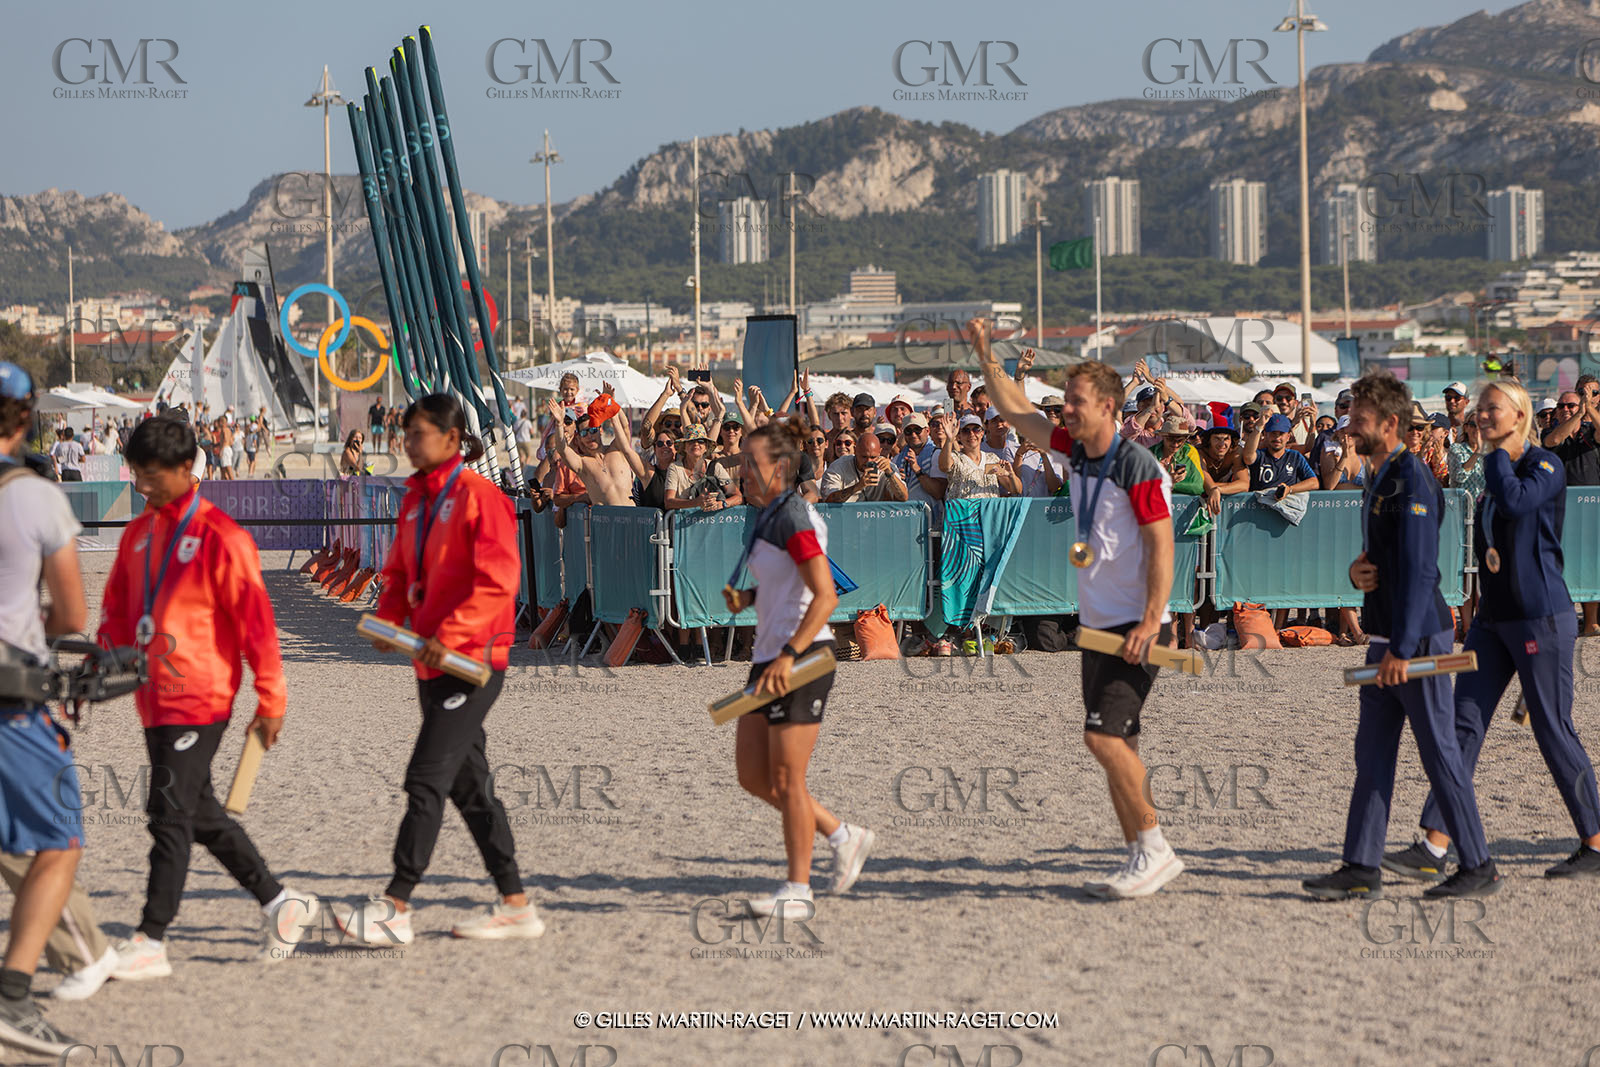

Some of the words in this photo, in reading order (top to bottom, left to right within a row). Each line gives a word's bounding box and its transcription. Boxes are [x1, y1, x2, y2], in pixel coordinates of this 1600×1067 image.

[1259, 466, 1274, 484] 10
[226, 495, 291, 516] PARIS
[1228, 502, 1257, 510] PARIS
[1311, 500, 1341, 508] PARIS
[1344, 499, 1364, 508] 202
[856, 510, 886, 519] PARIS
[889, 508, 917, 518] 2024
[685, 516, 716, 525] PARIS
[719, 515, 746, 524] 2024
